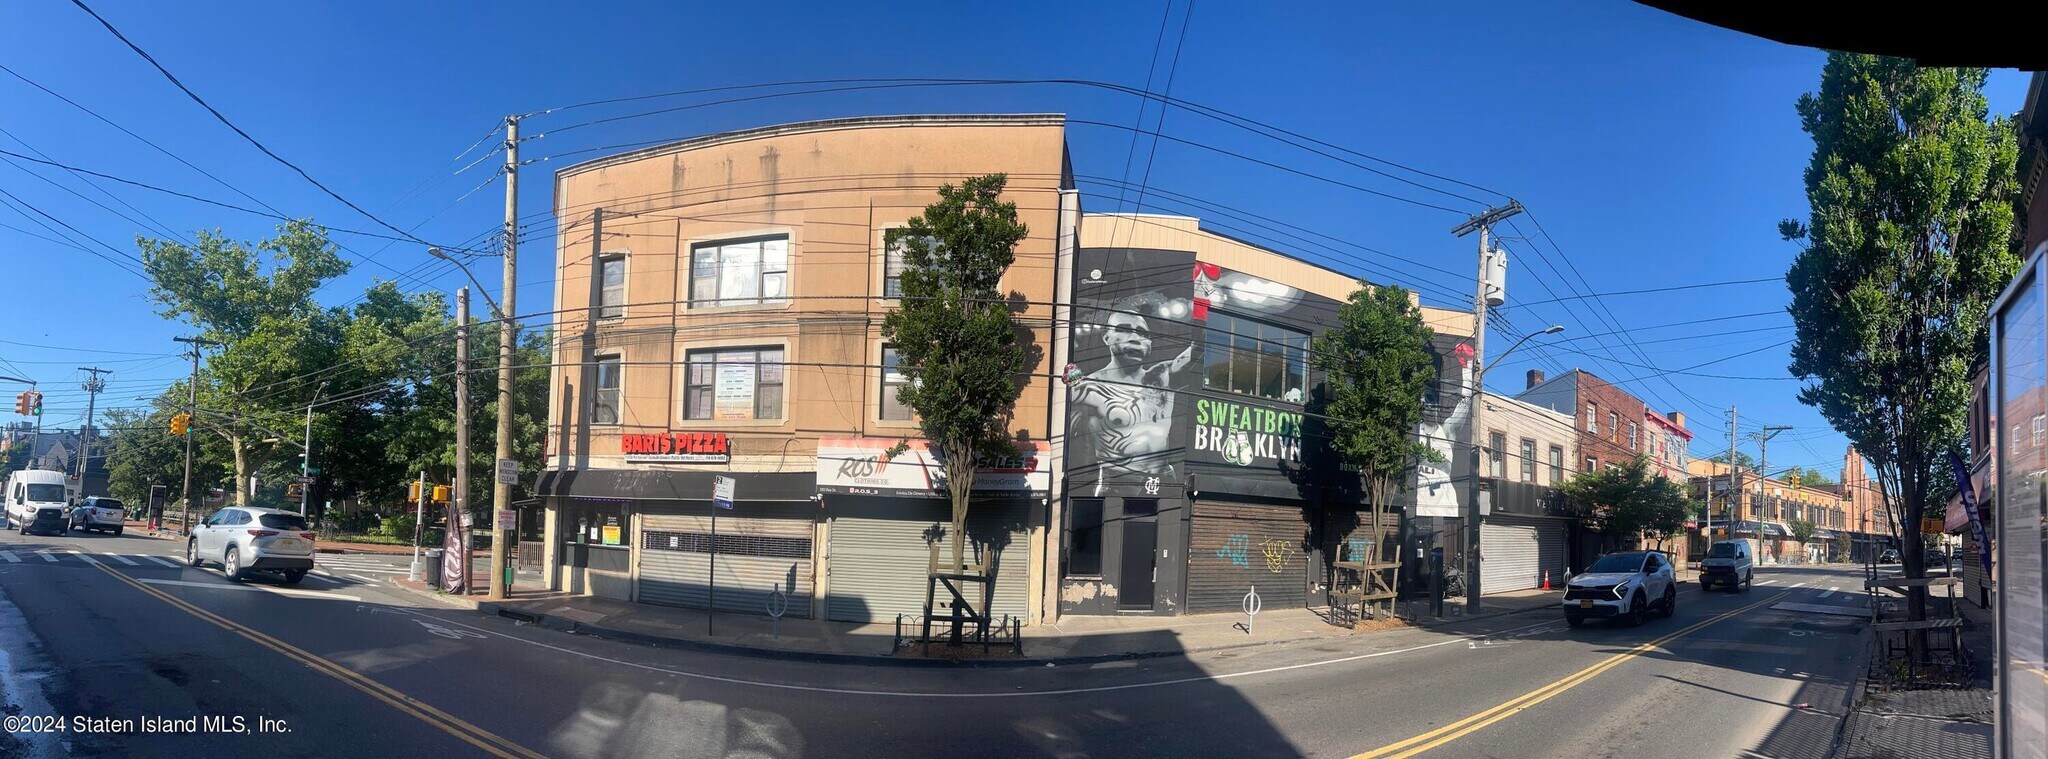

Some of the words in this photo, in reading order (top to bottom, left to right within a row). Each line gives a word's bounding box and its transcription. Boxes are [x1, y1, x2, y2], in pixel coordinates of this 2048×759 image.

[1196, 399, 1303, 438] SWEATBOX
[675, 432, 727, 453] PIZZA
[836, 455, 878, 479] ROS
[1418, 465, 1435, 475] ALI
[977, 478, 1019, 486] MoneyGram
